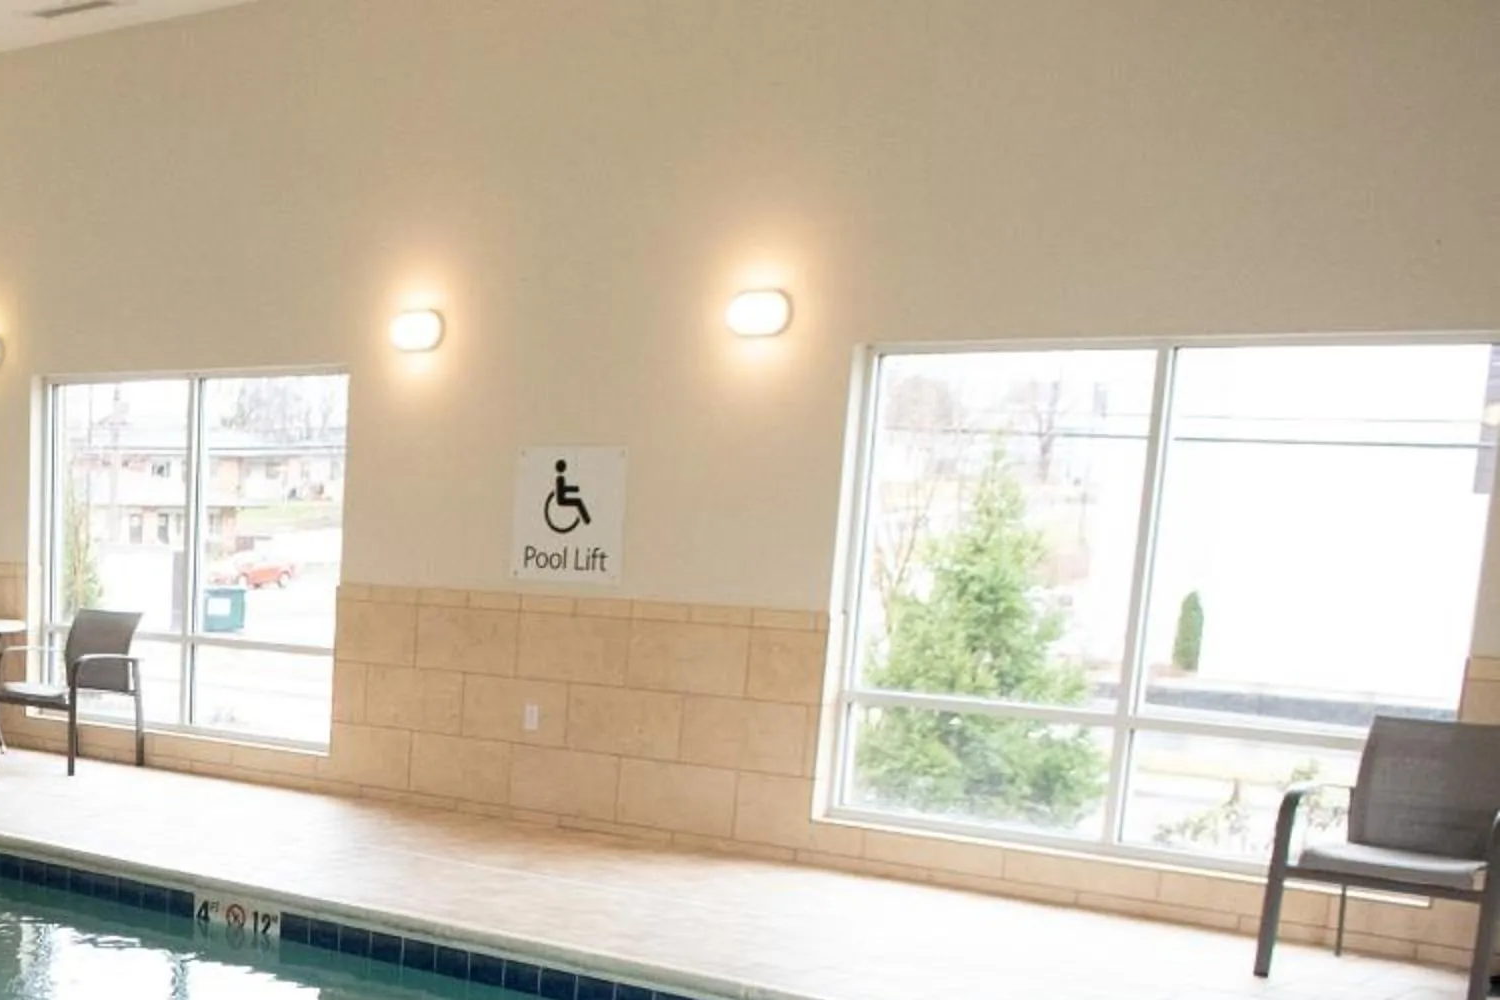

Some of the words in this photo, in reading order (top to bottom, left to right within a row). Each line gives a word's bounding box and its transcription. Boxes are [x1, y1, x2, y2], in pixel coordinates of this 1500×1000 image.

[523, 545, 567, 569] Pool
[574, 547, 608, 572] Lift
[197, 900, 210, 921] 4
